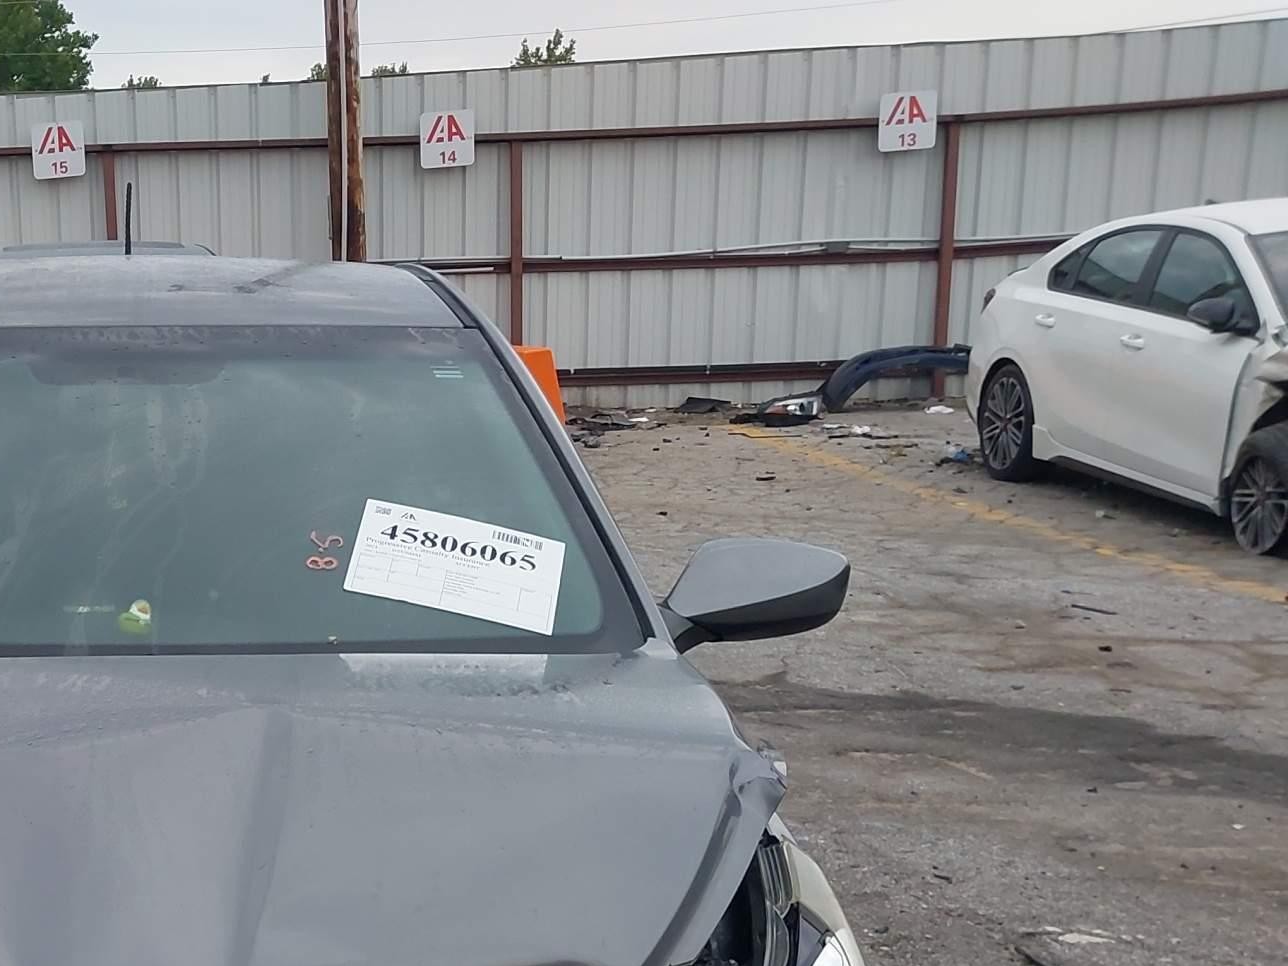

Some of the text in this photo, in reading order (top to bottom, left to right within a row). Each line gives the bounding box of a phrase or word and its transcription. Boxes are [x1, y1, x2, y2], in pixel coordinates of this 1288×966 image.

[898, 132, 917, 147] 13
[439, 150, 457, 164] 14
[51, 161, 69, 175] 15
[380, 524, 537, 571] 45806065
